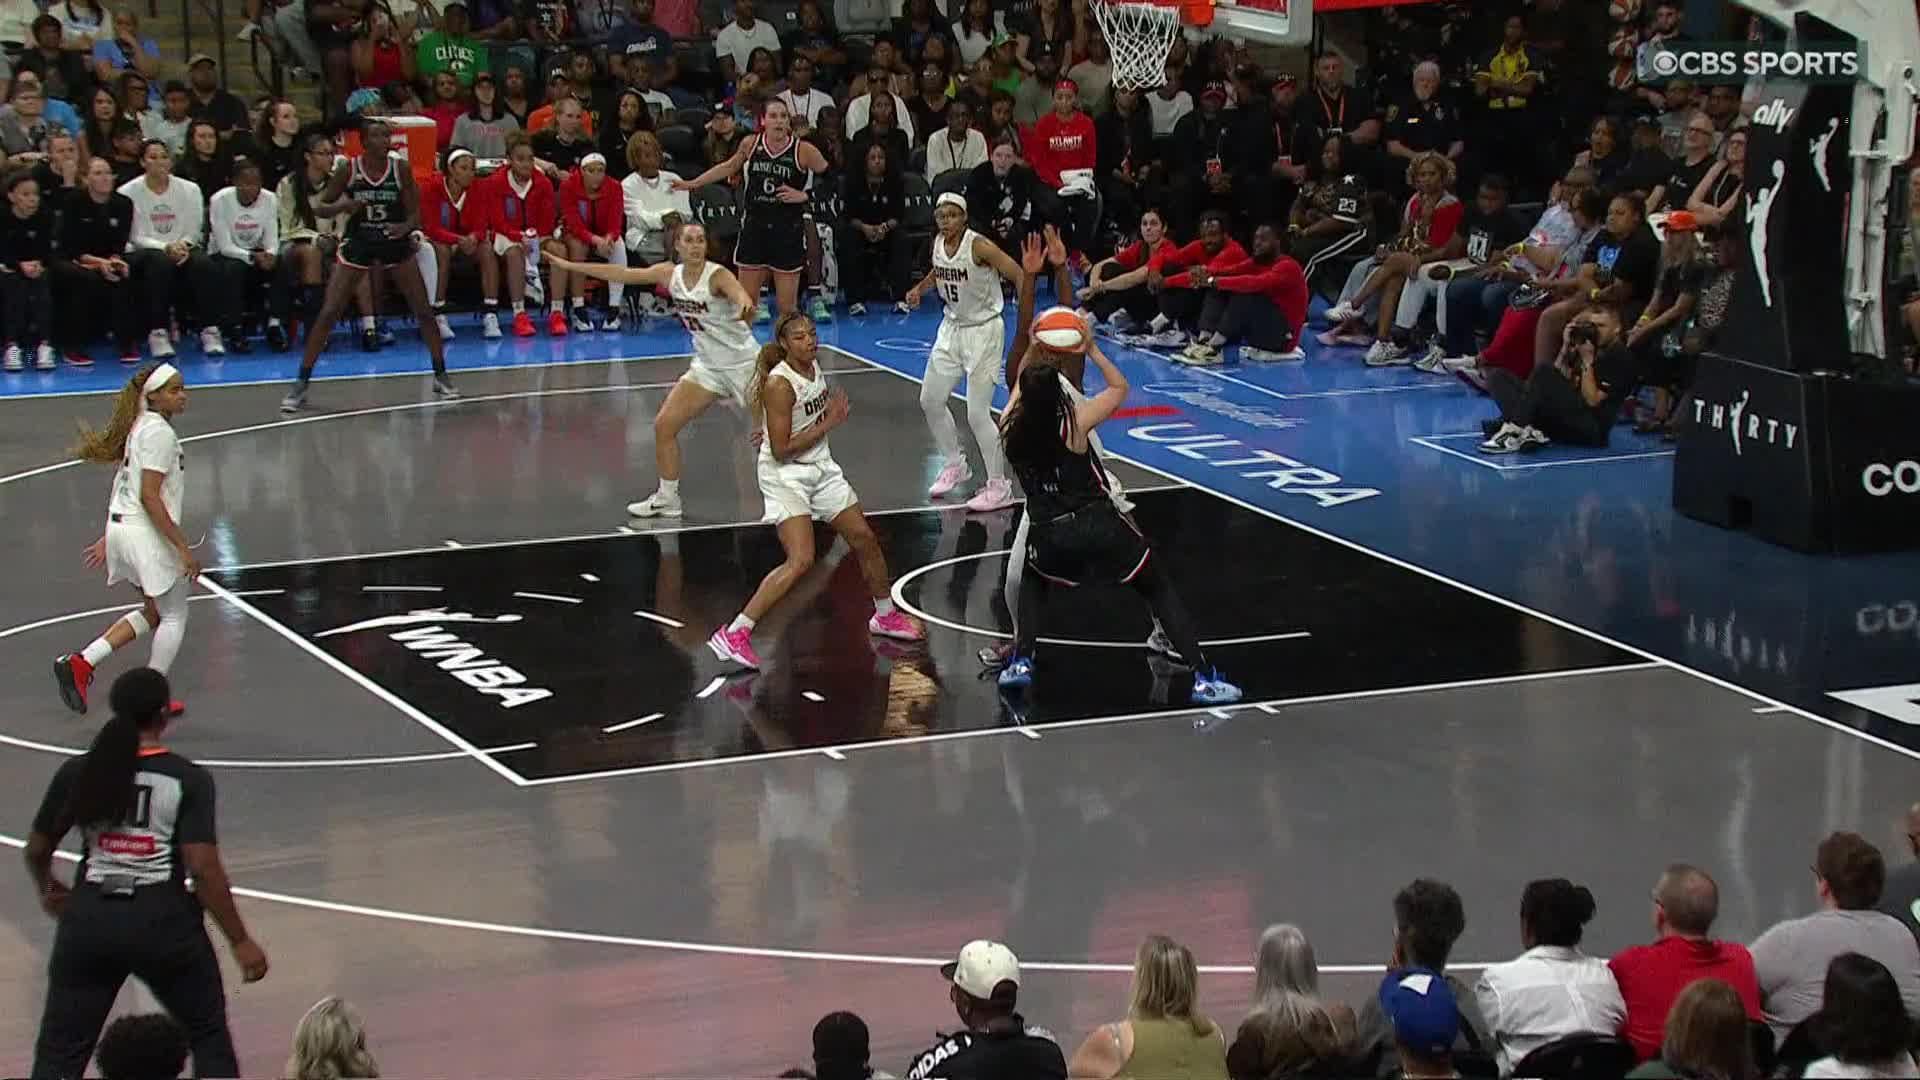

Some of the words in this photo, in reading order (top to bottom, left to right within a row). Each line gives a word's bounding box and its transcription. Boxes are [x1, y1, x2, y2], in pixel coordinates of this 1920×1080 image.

[1753, 98, 1794, 134] ally
[763, 176, 776, 194] 6
[1338, 198, 1357, 214] 23
[944, 282, 959, 303] 15
[1127, 422, 1383, 509] ULTRA
[388, 625, 554, 709] WNBA
